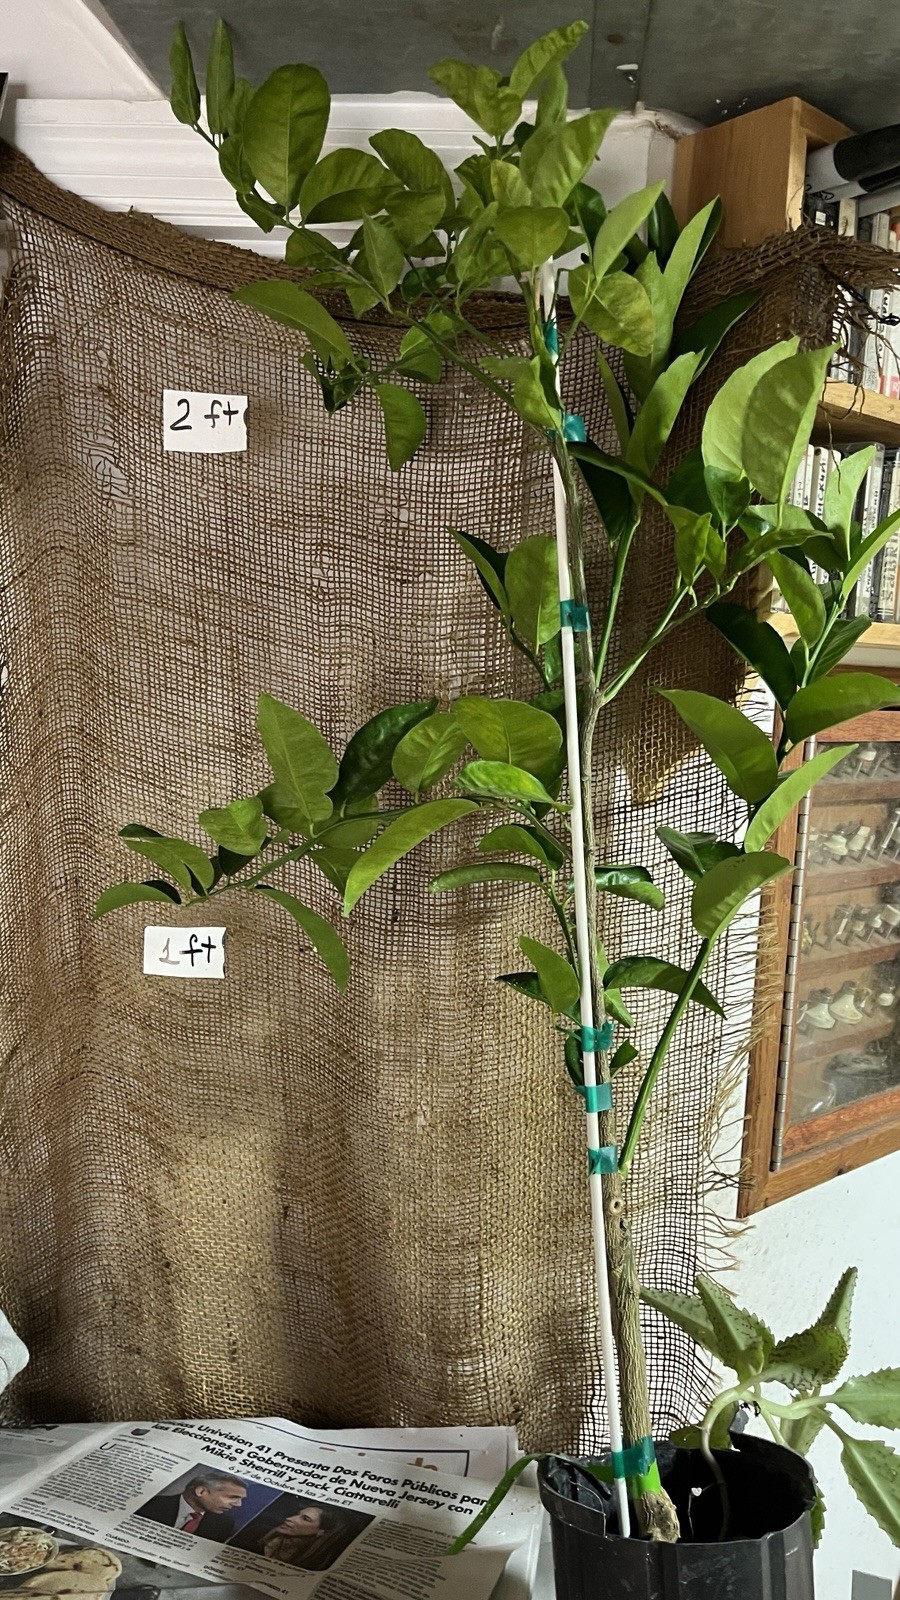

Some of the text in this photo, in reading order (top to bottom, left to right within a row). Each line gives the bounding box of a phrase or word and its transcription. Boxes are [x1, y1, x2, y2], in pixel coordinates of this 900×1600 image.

[169, 398, 239, 431] 2 ft
[159, 933, 217, 967] 1 ft
[151, 1423, 170, 1431] las
[171, 1427, 233, 1450] Elecciones
[247, 1451, 327, 1480] Gobernador
[329, 1475, 347, 1485] de
[349, 1478, 397, 1497] Nueva
[398, 1491, 446, 1510] Jersey
[447, 1504, 474, 1515] con
[197, 1425, 253, 1448] Univision
[255, 1444, 272, 1454] 41
[273, 1451, 331, 1472] Presenta
[332, 1465, 359, 1477] Dos
[361, 1470, 399, 1486] Foros
[401, 1478, 459, 1500] Públicos
[459, 1494, 488, 1506] par
[200, 1445, 237, 1462] Mikie
[239, 1459, 287, 1478] Sherrill
[298, 1478, 331, 1492] Jack
[333, 1487, 401, 1509] Ciattarelli
[263, 1477, 296, 1491] Octubre
[304, 1489, 316, 1497] las
[324, 1496, 340, 1504] pm
